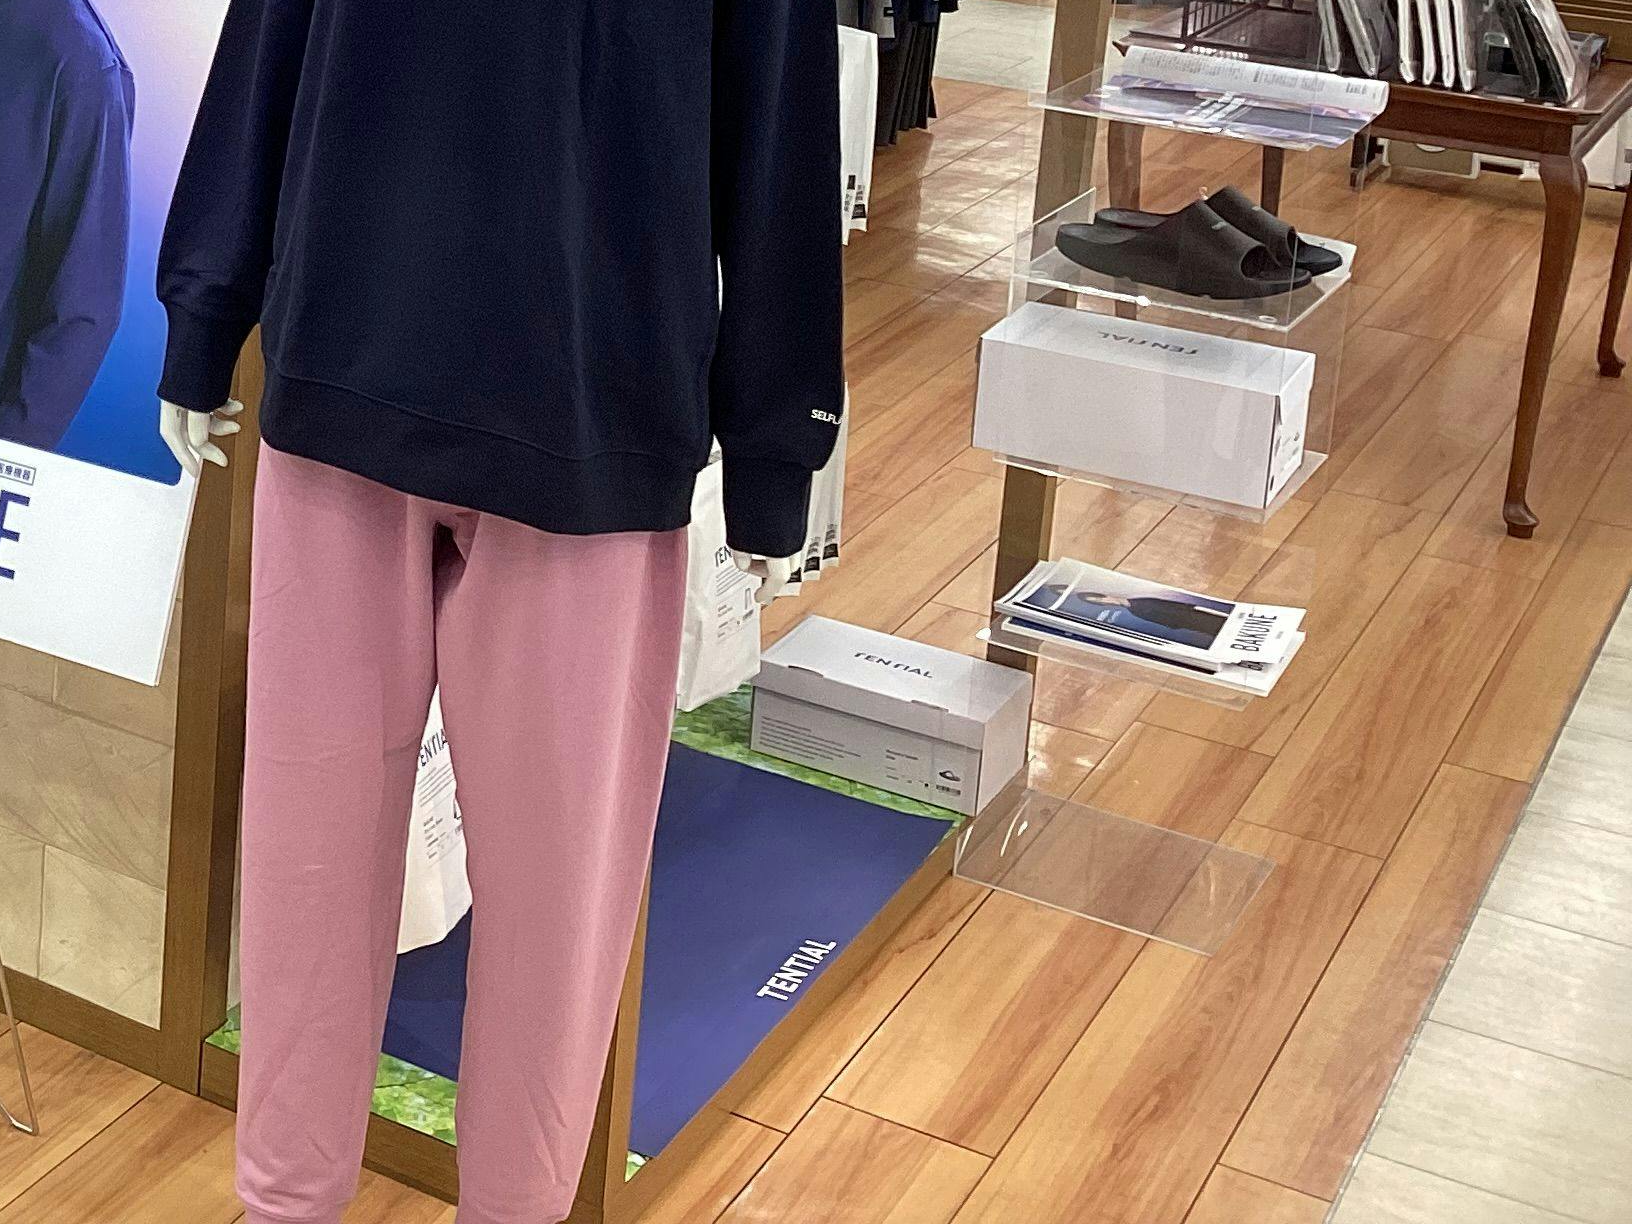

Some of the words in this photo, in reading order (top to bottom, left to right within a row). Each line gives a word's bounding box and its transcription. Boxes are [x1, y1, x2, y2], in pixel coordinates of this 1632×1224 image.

[1230, 612, 1278, 652] BAKUNE
[854, 651, 934, 679] TENTIAL
[756, 939, 837, 1001] TENTIAL
